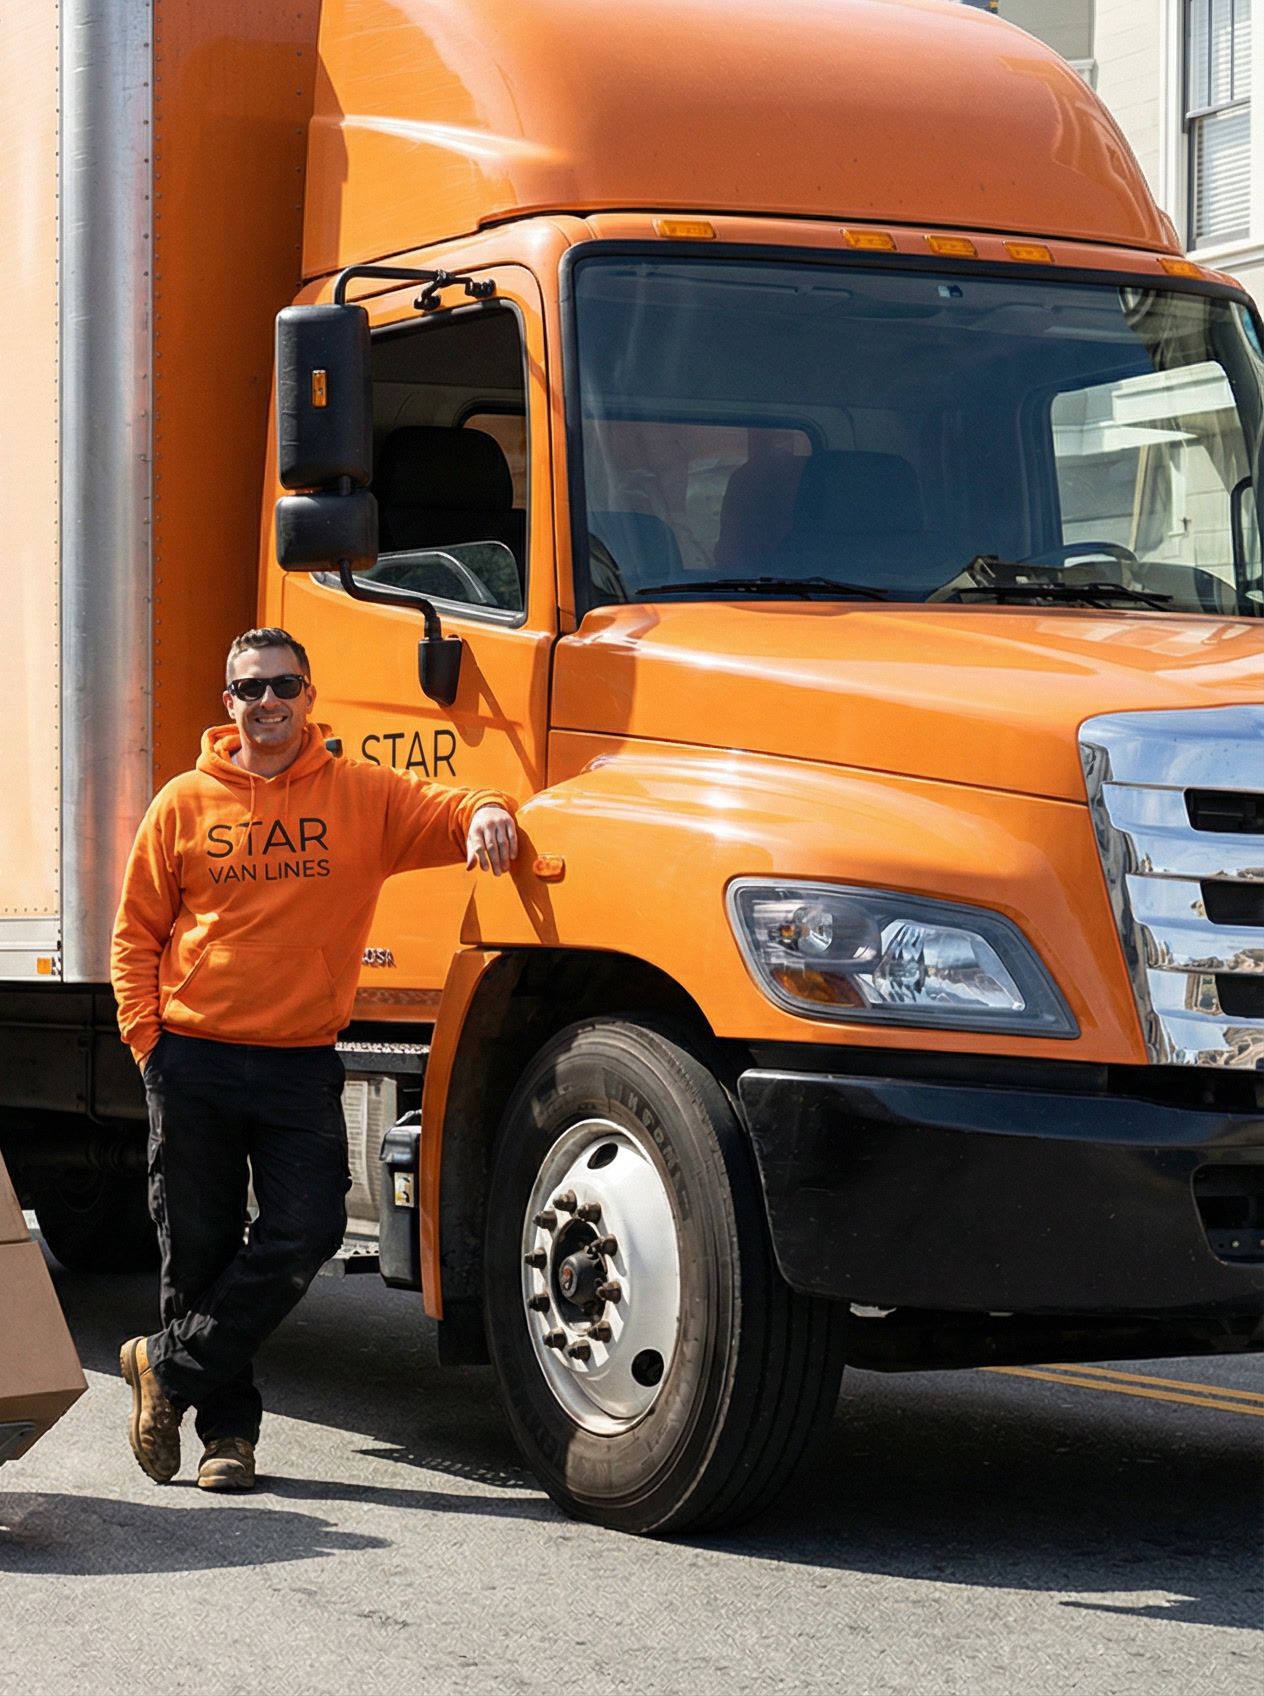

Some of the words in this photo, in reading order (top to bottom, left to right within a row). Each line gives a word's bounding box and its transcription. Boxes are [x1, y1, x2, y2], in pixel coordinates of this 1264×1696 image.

[361, 729, 457, 778] STAR
[206, 817, 329, 859] STAR
[208, 863, 257, 885] VAN
[264, 858, 331, 881] LINES
